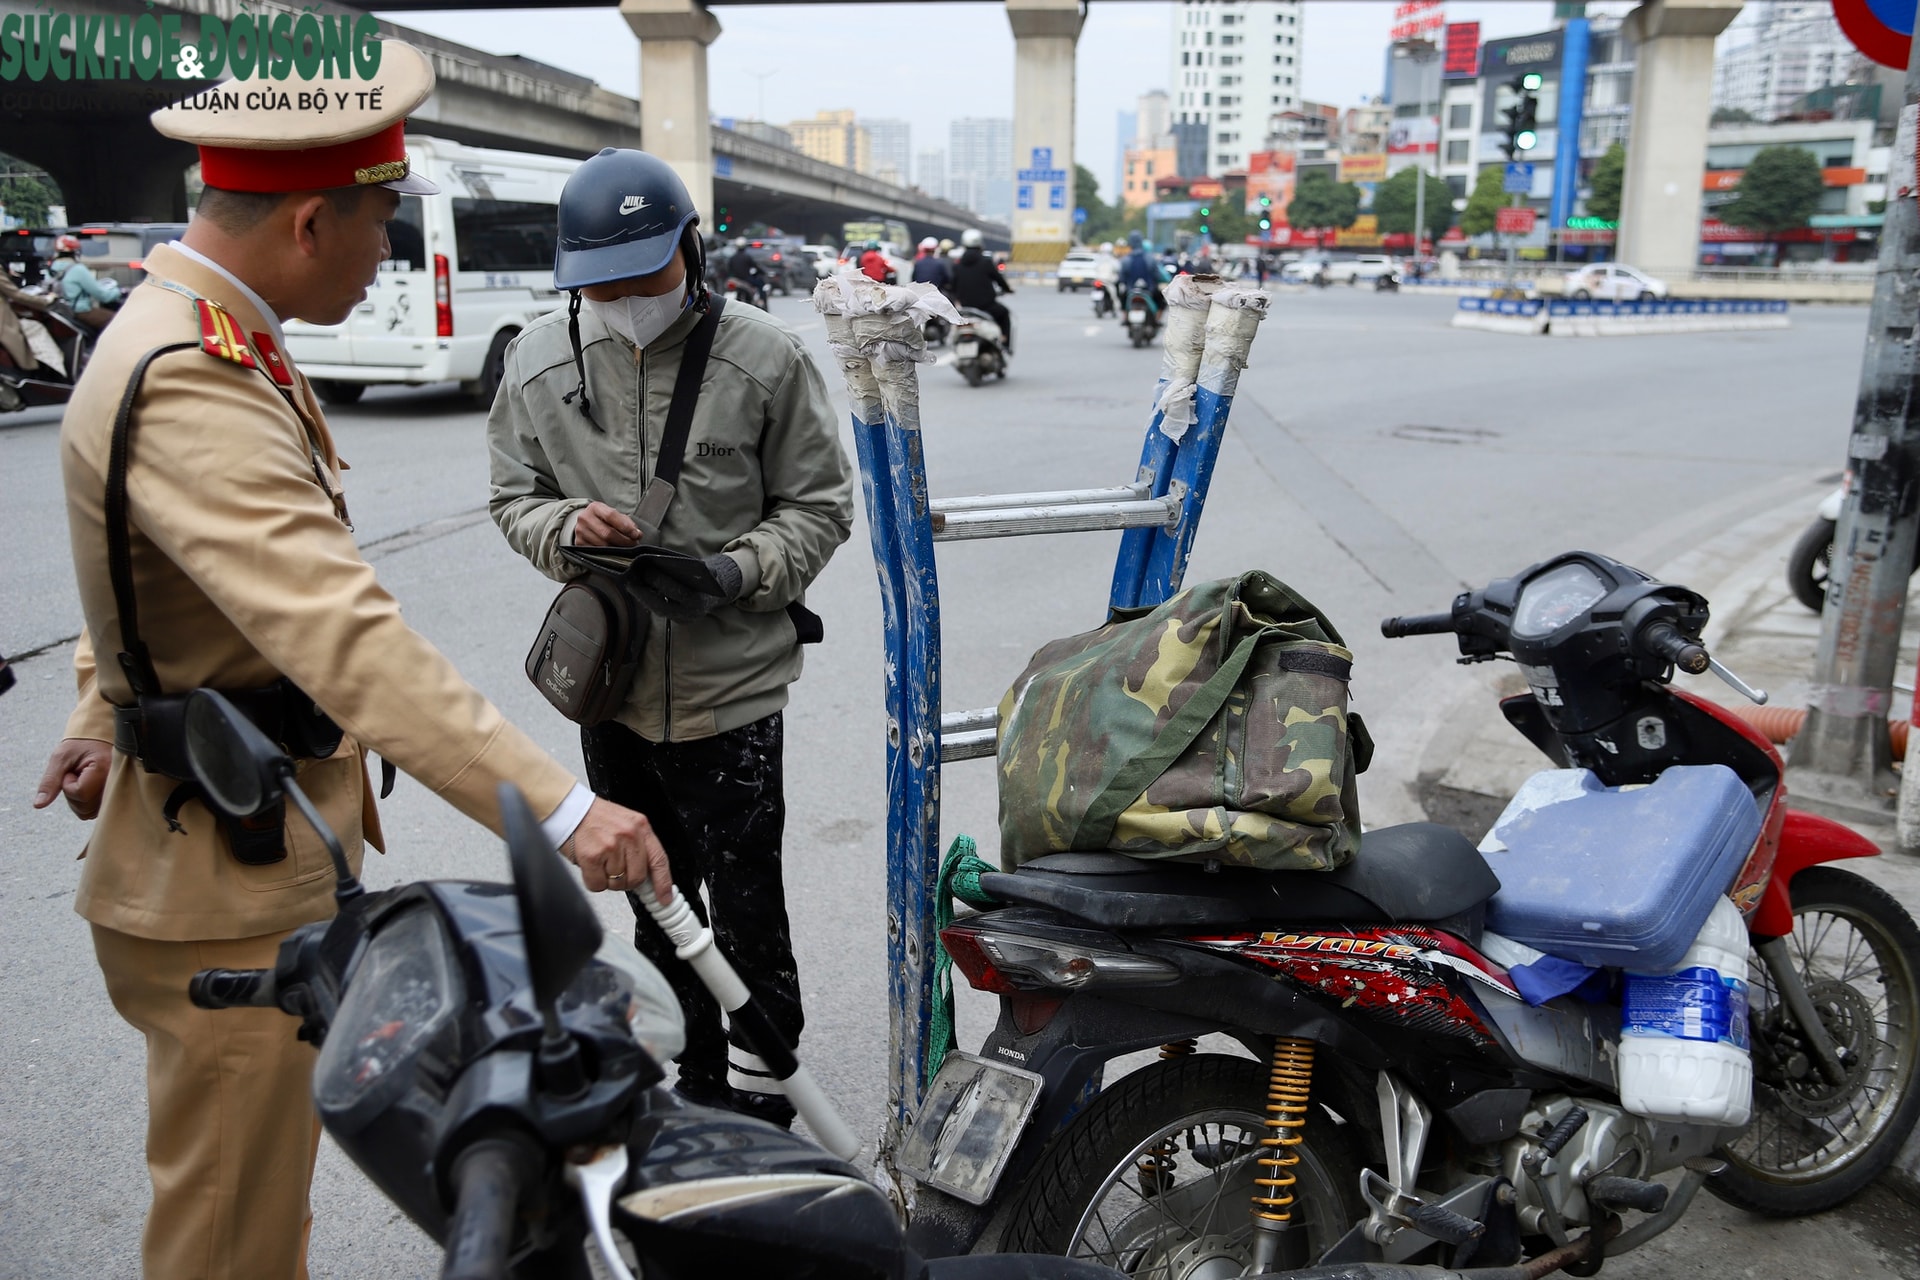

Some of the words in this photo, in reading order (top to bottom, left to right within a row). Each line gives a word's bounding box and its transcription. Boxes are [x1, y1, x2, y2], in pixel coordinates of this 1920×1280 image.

[624, 195, 645, 207] NIKE
[696, 442, 736, 457] Dior
[546, 678, 570, 703] adidas
[998, 1046, 1025, 1061] HONDA
